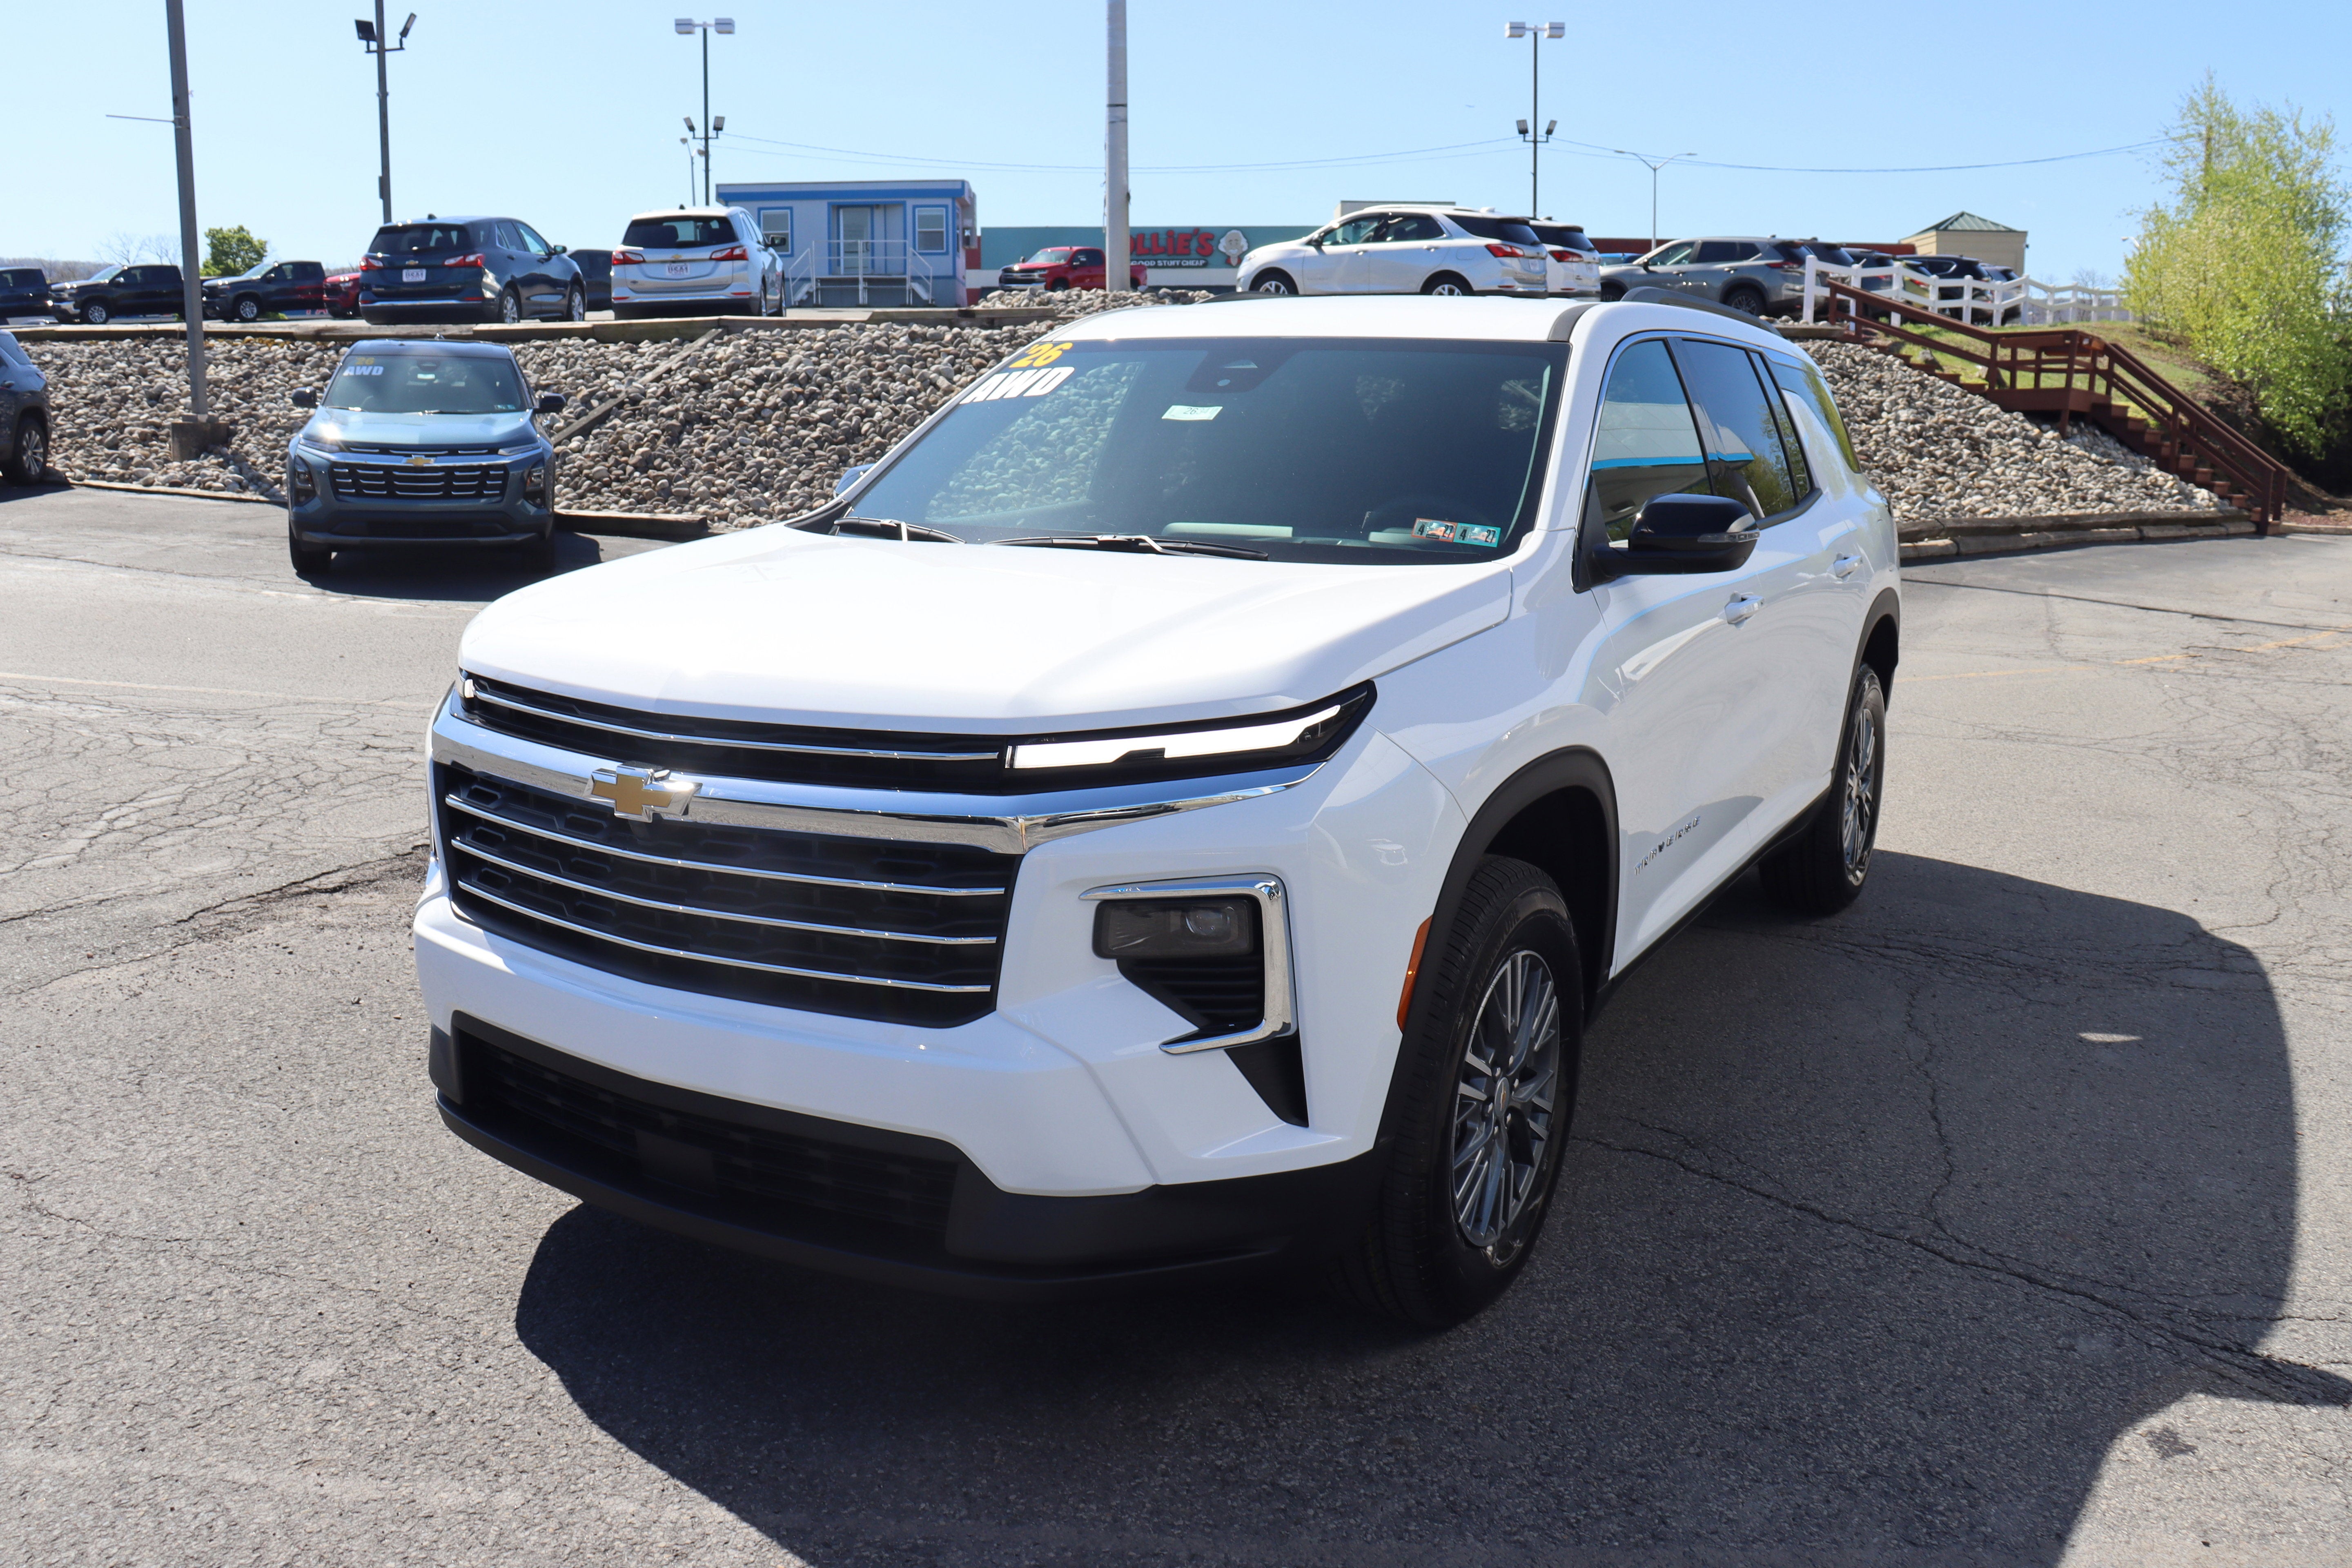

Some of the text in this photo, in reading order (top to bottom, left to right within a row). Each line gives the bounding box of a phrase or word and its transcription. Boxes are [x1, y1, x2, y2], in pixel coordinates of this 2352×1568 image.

[1130, 228, 1214, 256] LLiE'S
[343, 366, 384, 375] AWD
[959, 367, 1075, 404] AWD
[1418, 524, 1454, 538] 4 27
[1460, 529, 1496, 543] 4 27
